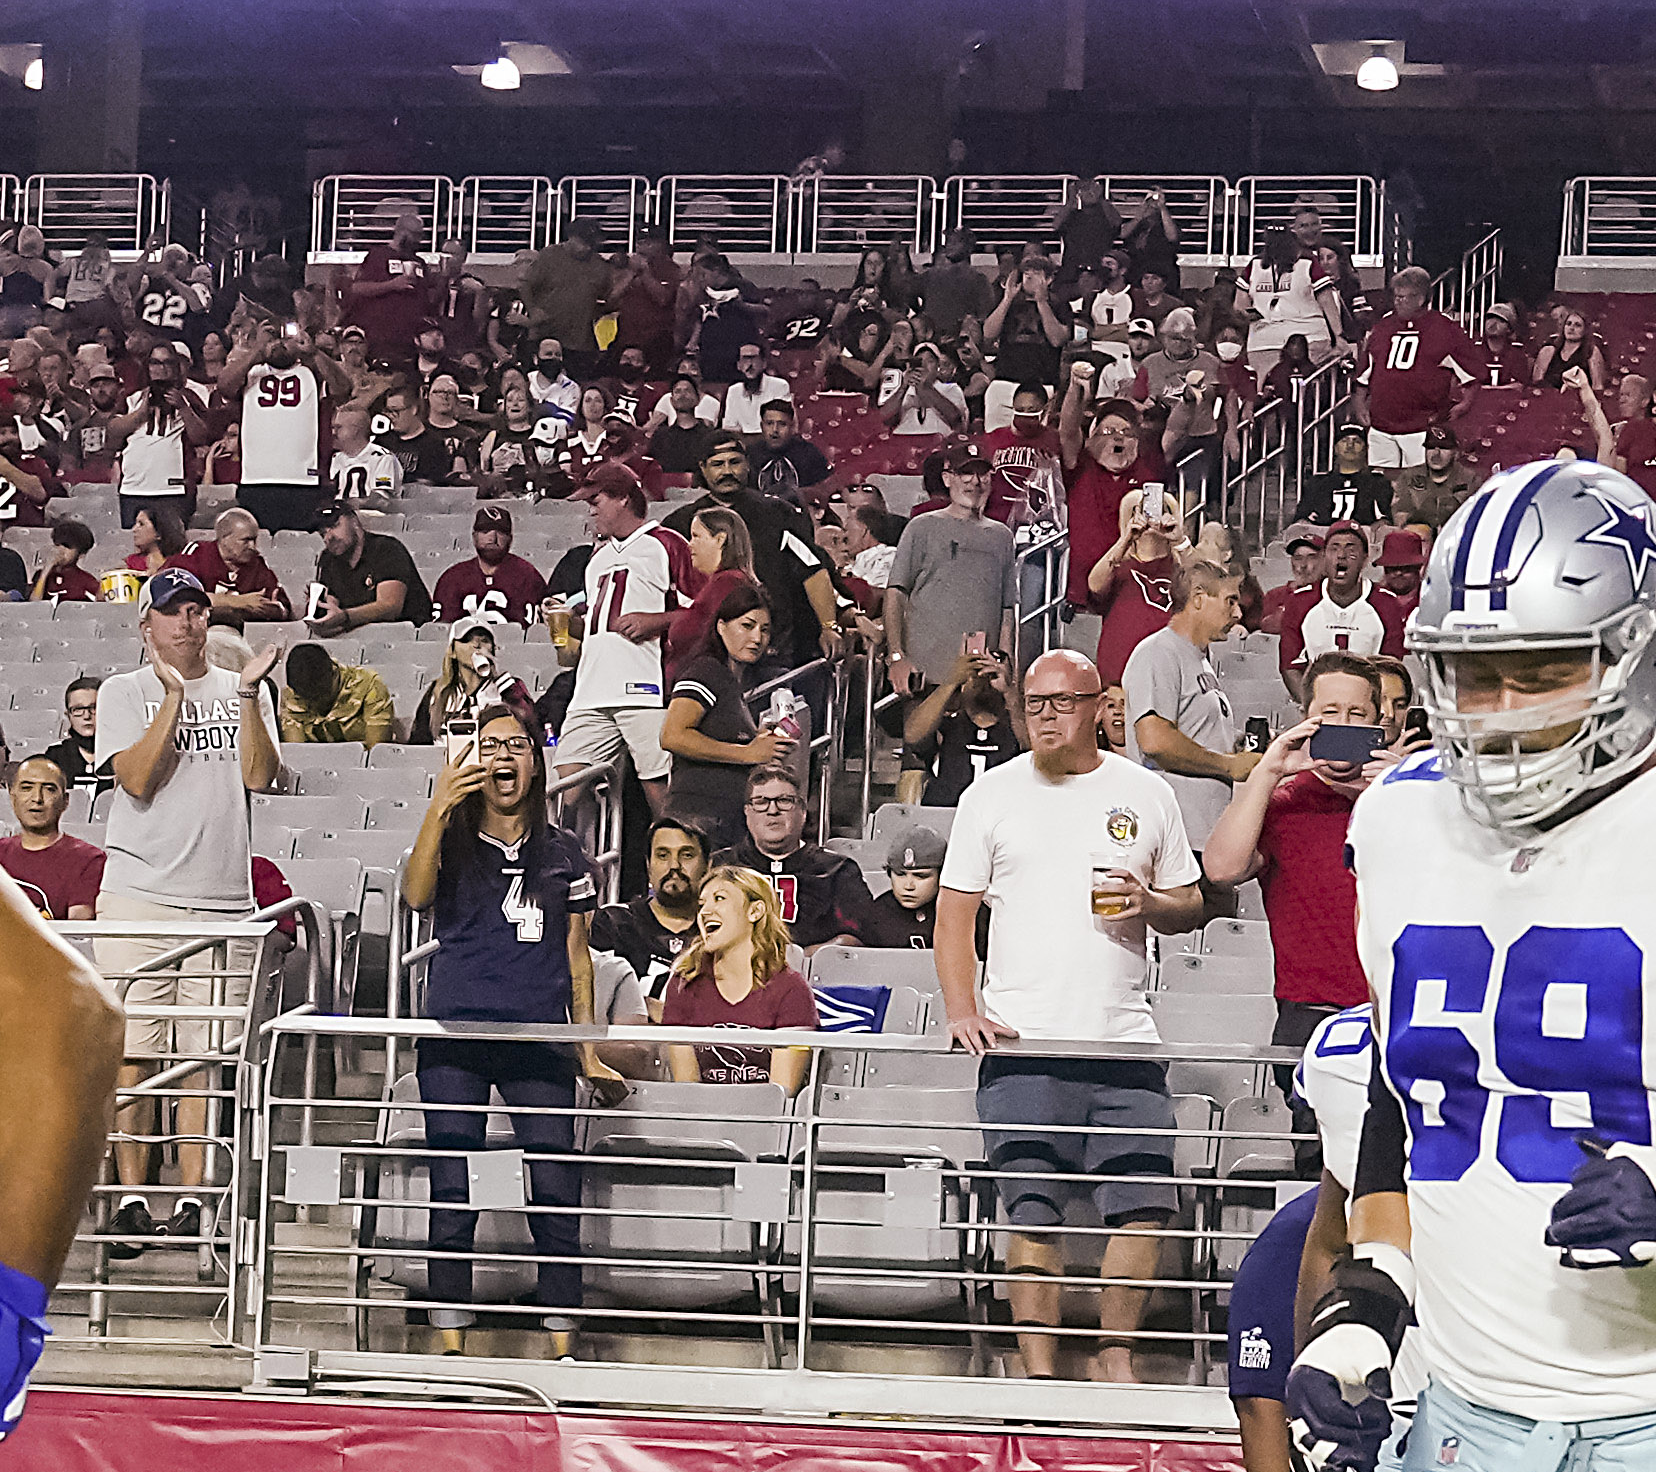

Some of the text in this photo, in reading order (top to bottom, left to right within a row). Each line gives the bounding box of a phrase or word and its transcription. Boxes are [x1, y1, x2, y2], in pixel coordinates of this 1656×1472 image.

[140, 291, 185, 325] 22
[786, 318, 821, 341] 32
[1386, 335, 1419, 370] 10
[258, 373, 301, 408] 99
[1331, 493, 1356, 521] 11
[590, 568, 630, 637] 11
[143, 701, 242, 725] DLLAS
[174, 725, 239, 752] WBOY
[501, 872, 544, 943] 4
[1386, 924, 1653, 1185] 69
